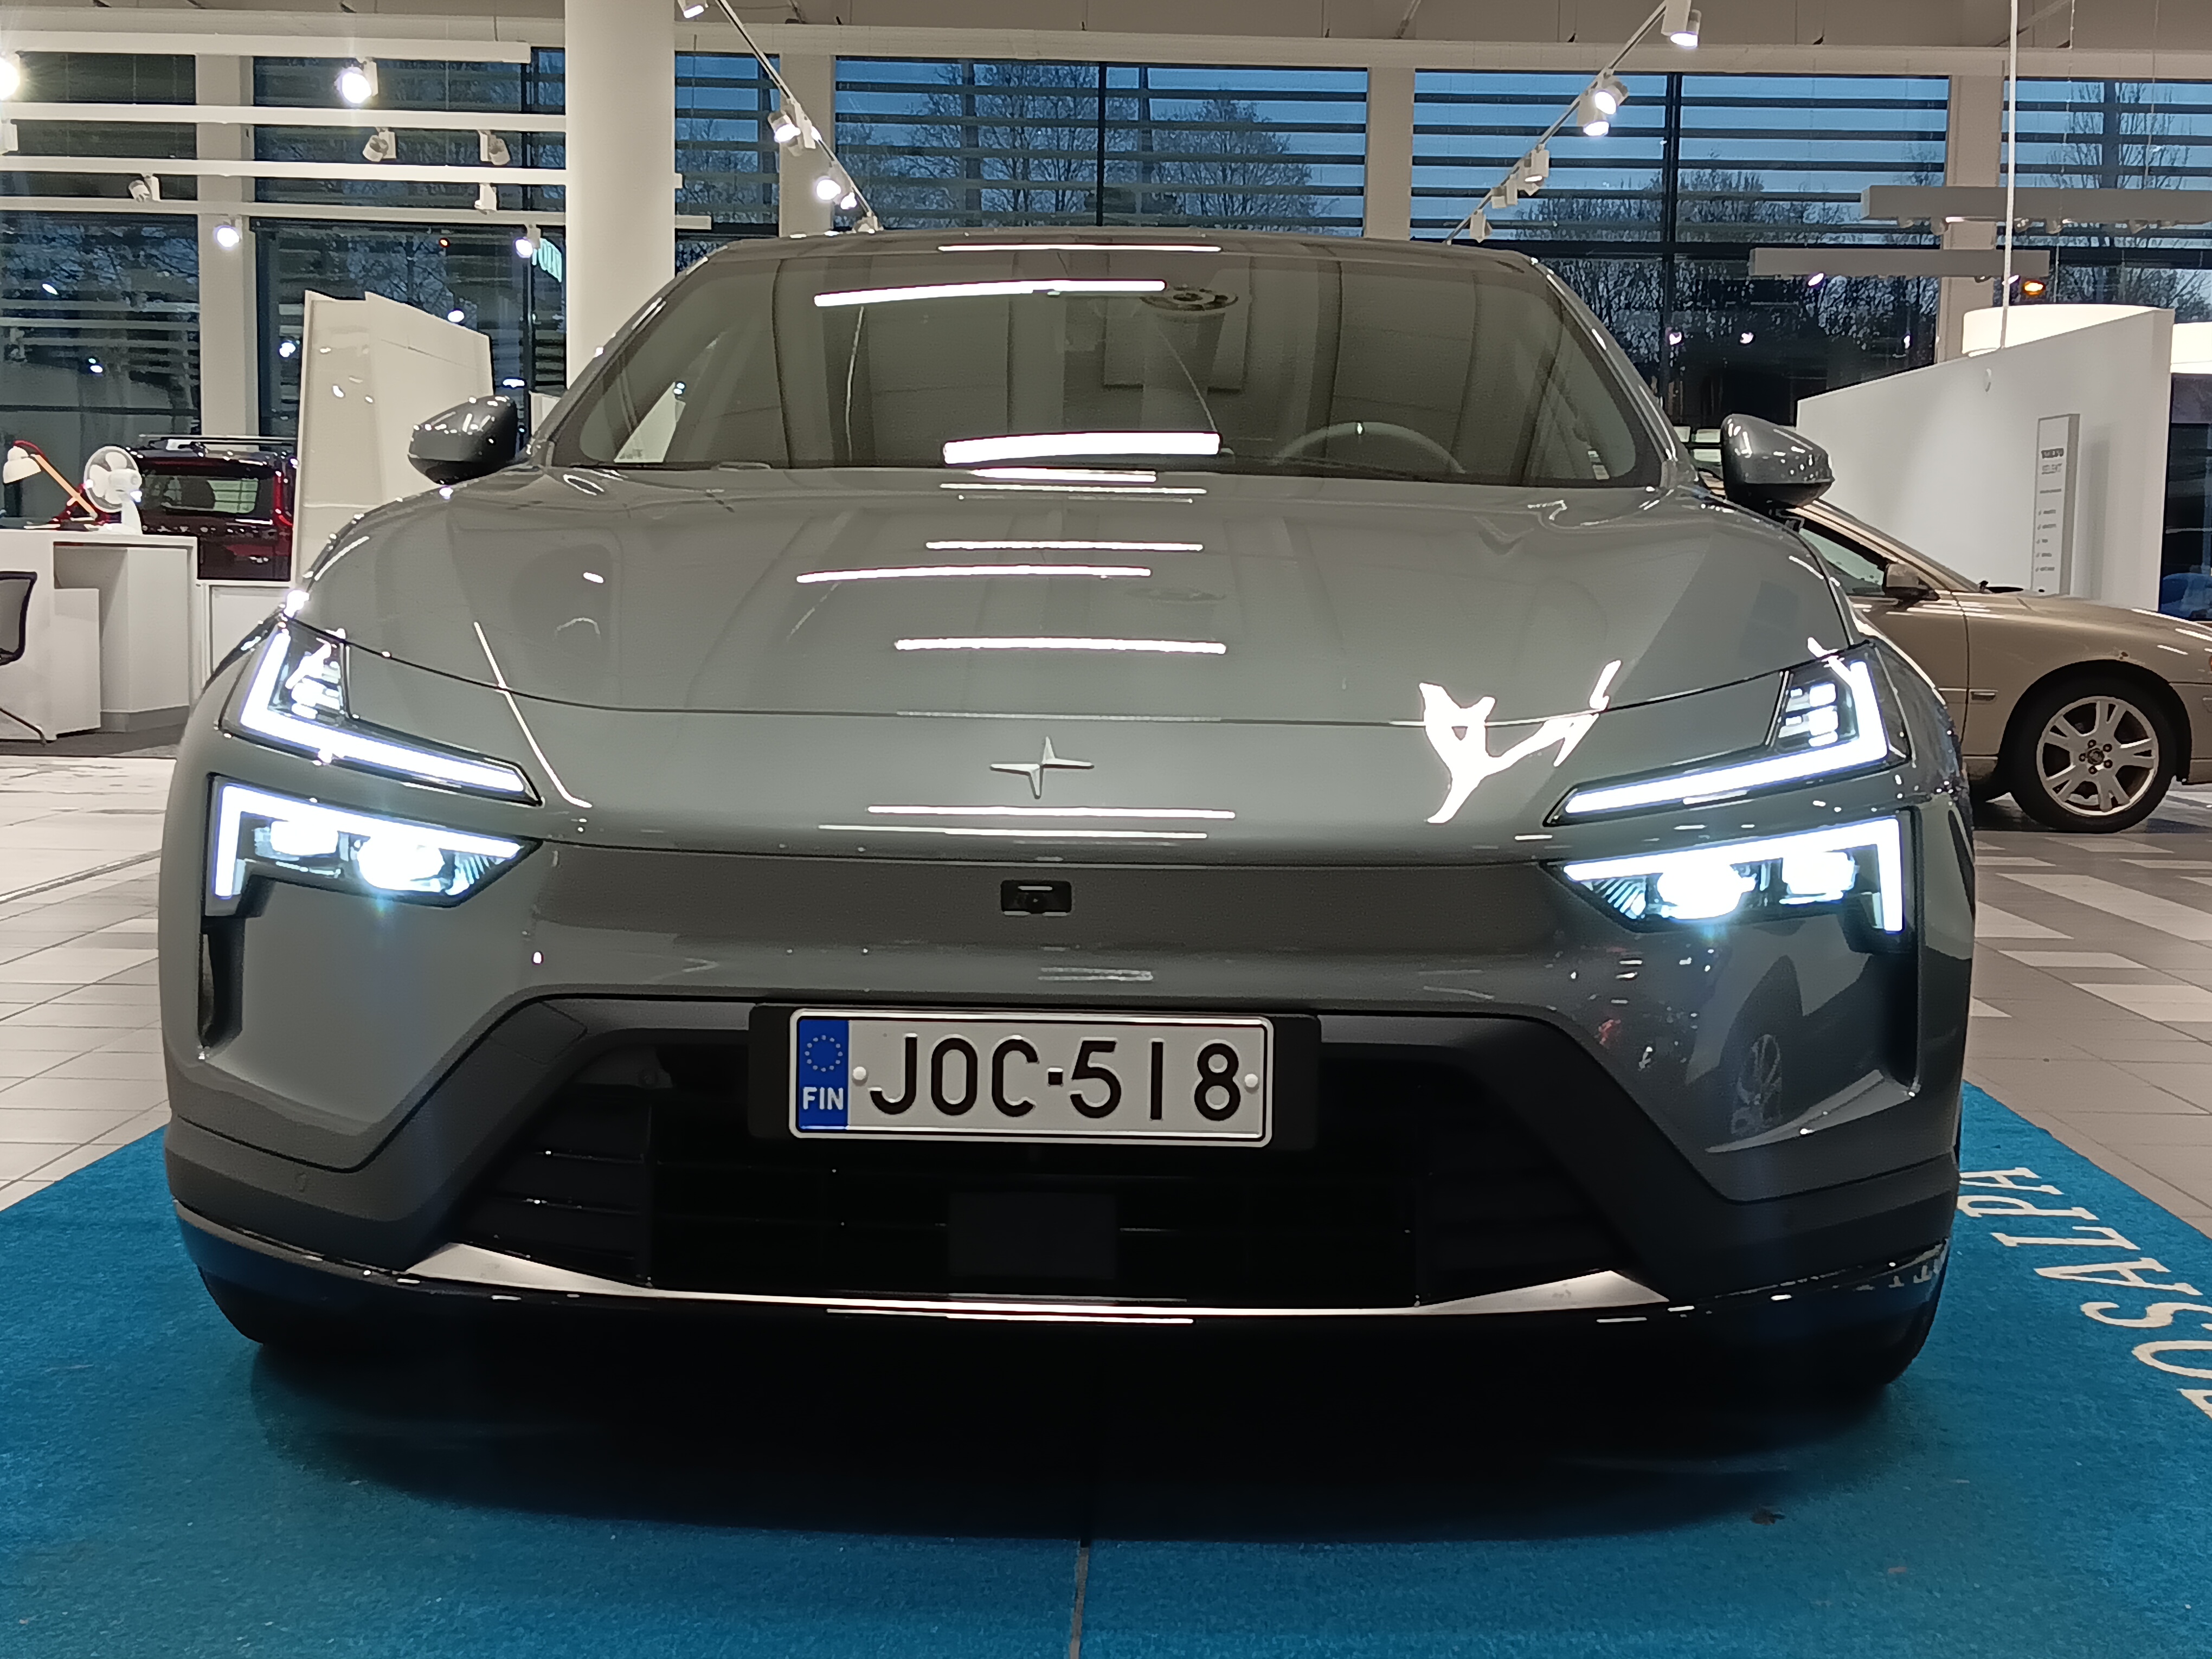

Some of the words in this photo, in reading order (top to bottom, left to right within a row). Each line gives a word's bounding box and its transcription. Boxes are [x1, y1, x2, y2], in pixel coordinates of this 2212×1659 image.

[803, 1086, 844, 1110] FIN
[869, 1034, 1241, 1121] JOC-518
[1957, 1167, 2212, 1420] OSALPA
